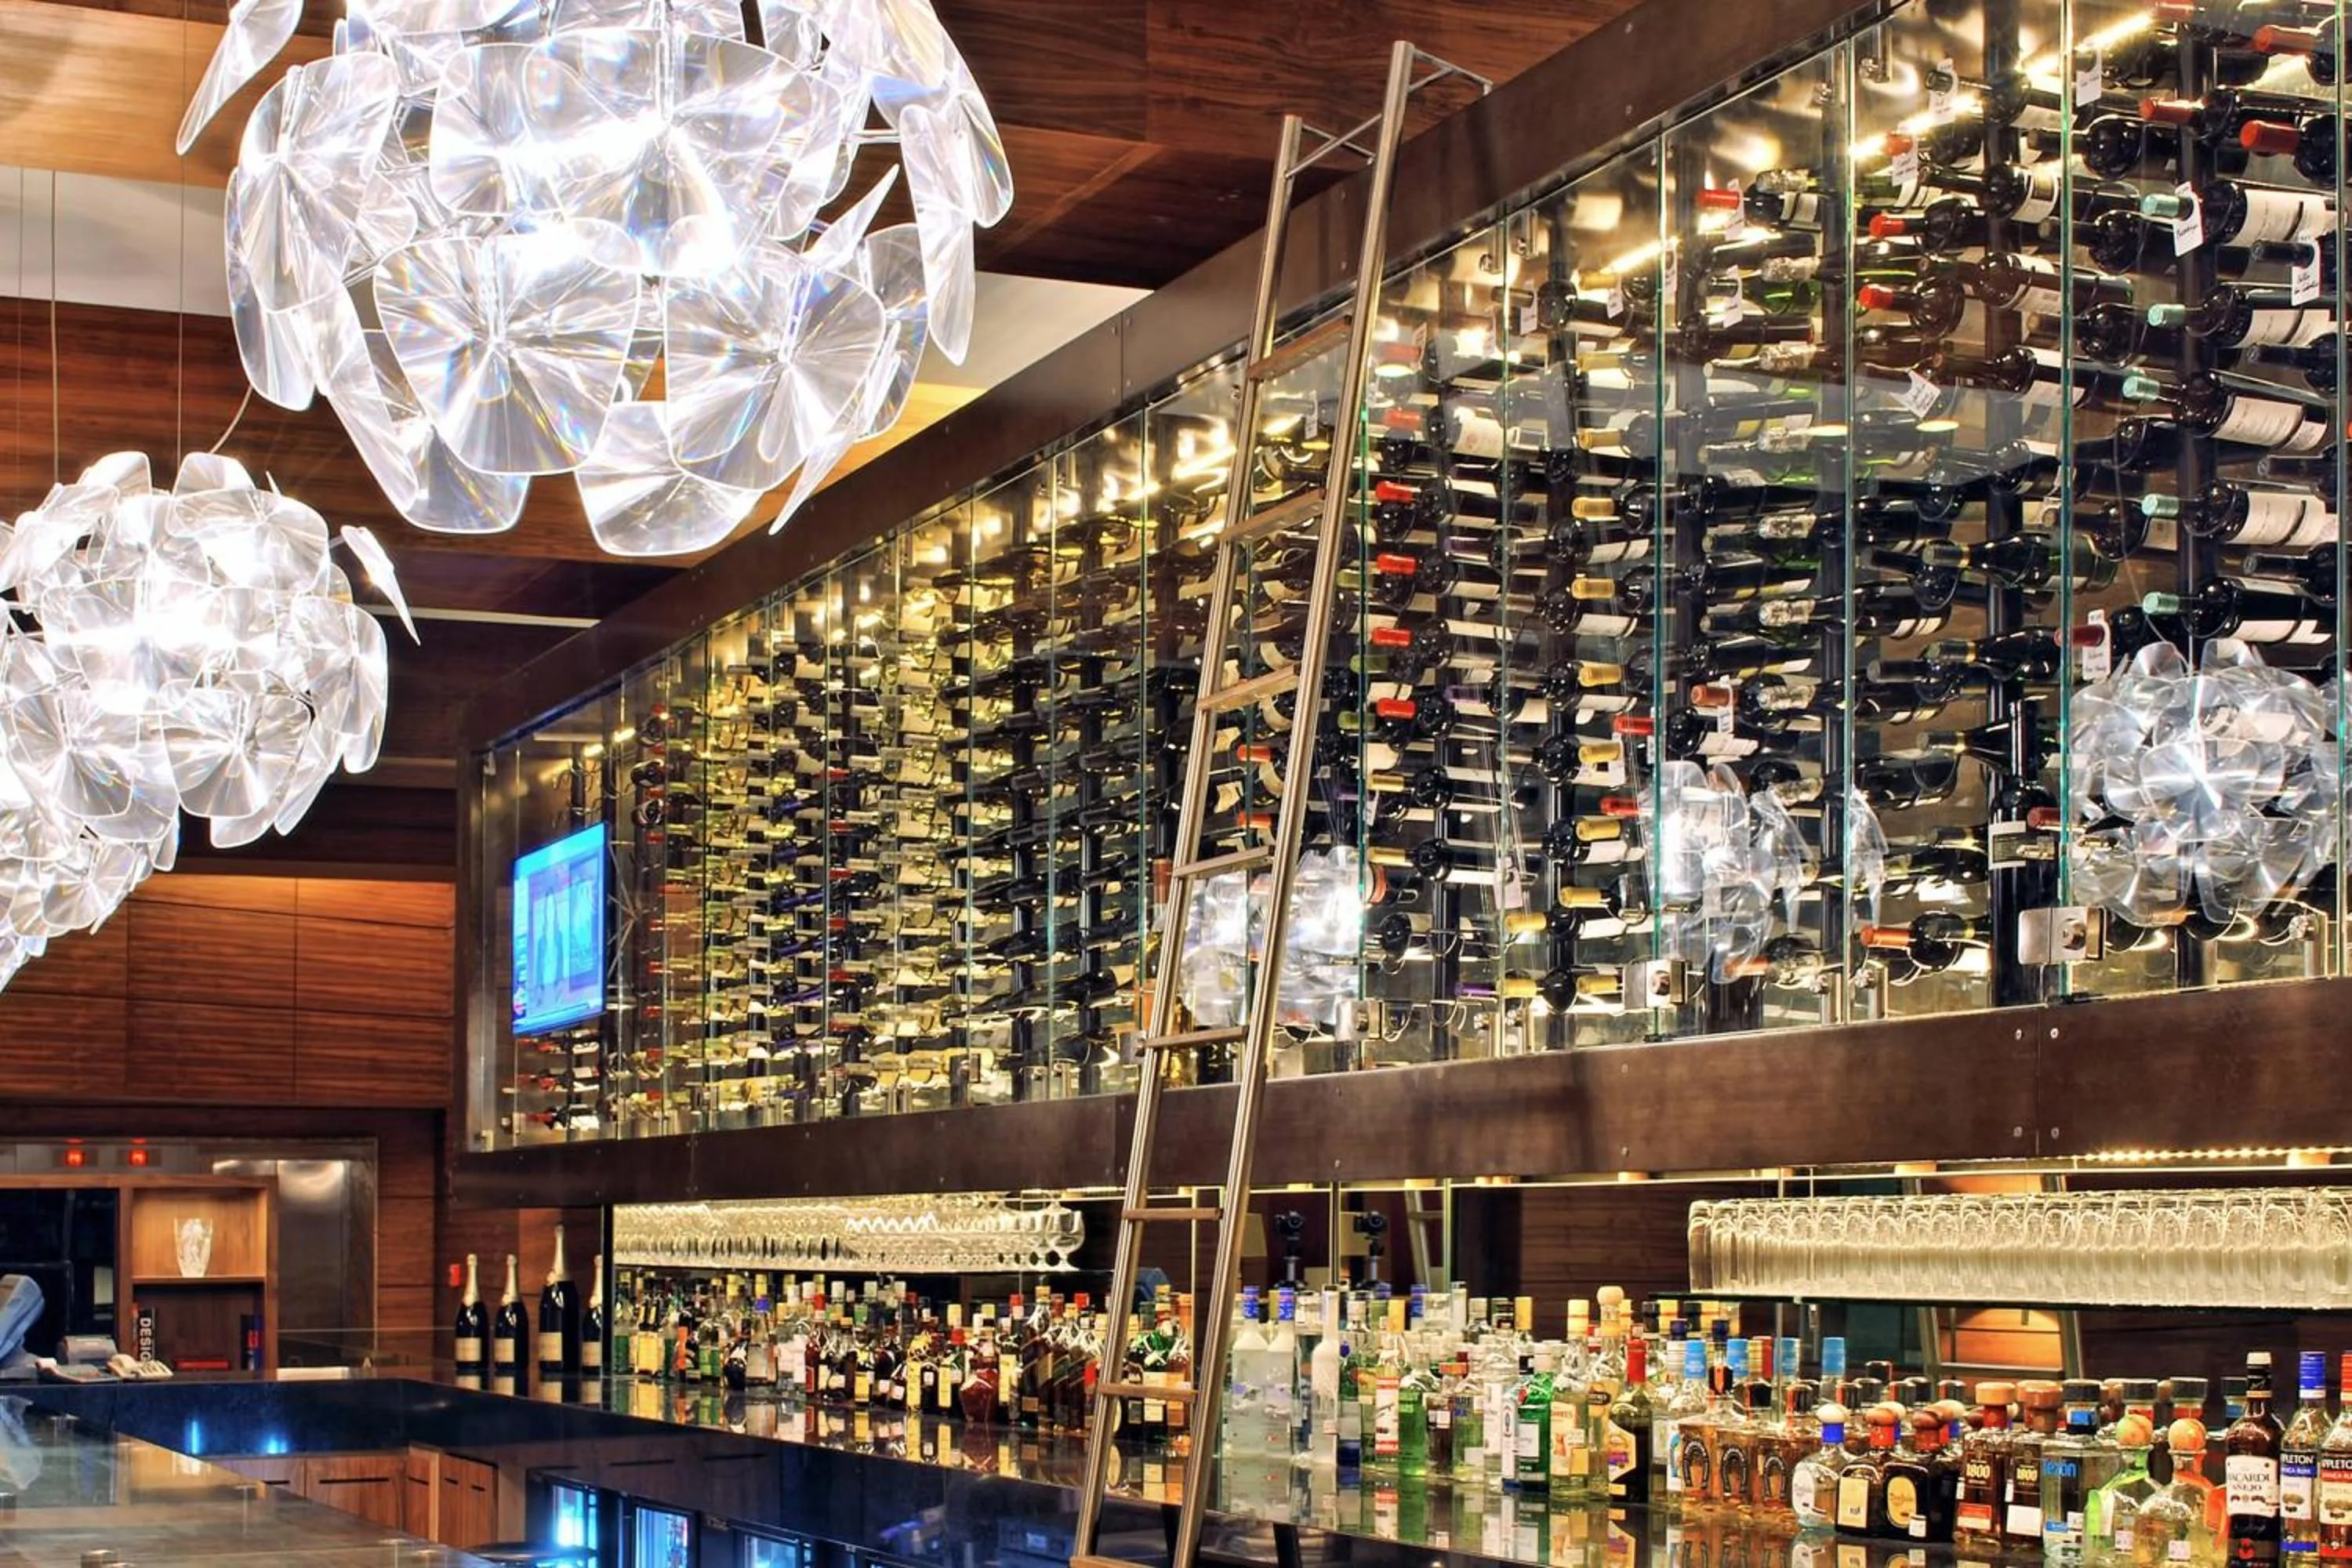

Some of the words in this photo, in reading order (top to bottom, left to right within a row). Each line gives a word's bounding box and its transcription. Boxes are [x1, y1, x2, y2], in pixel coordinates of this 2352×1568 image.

[140, 1317, 151, 1361] DESIG
[1965, 1463, 1991, 1479] 1800
[2016, 1467, 2038, 1482] 1800
